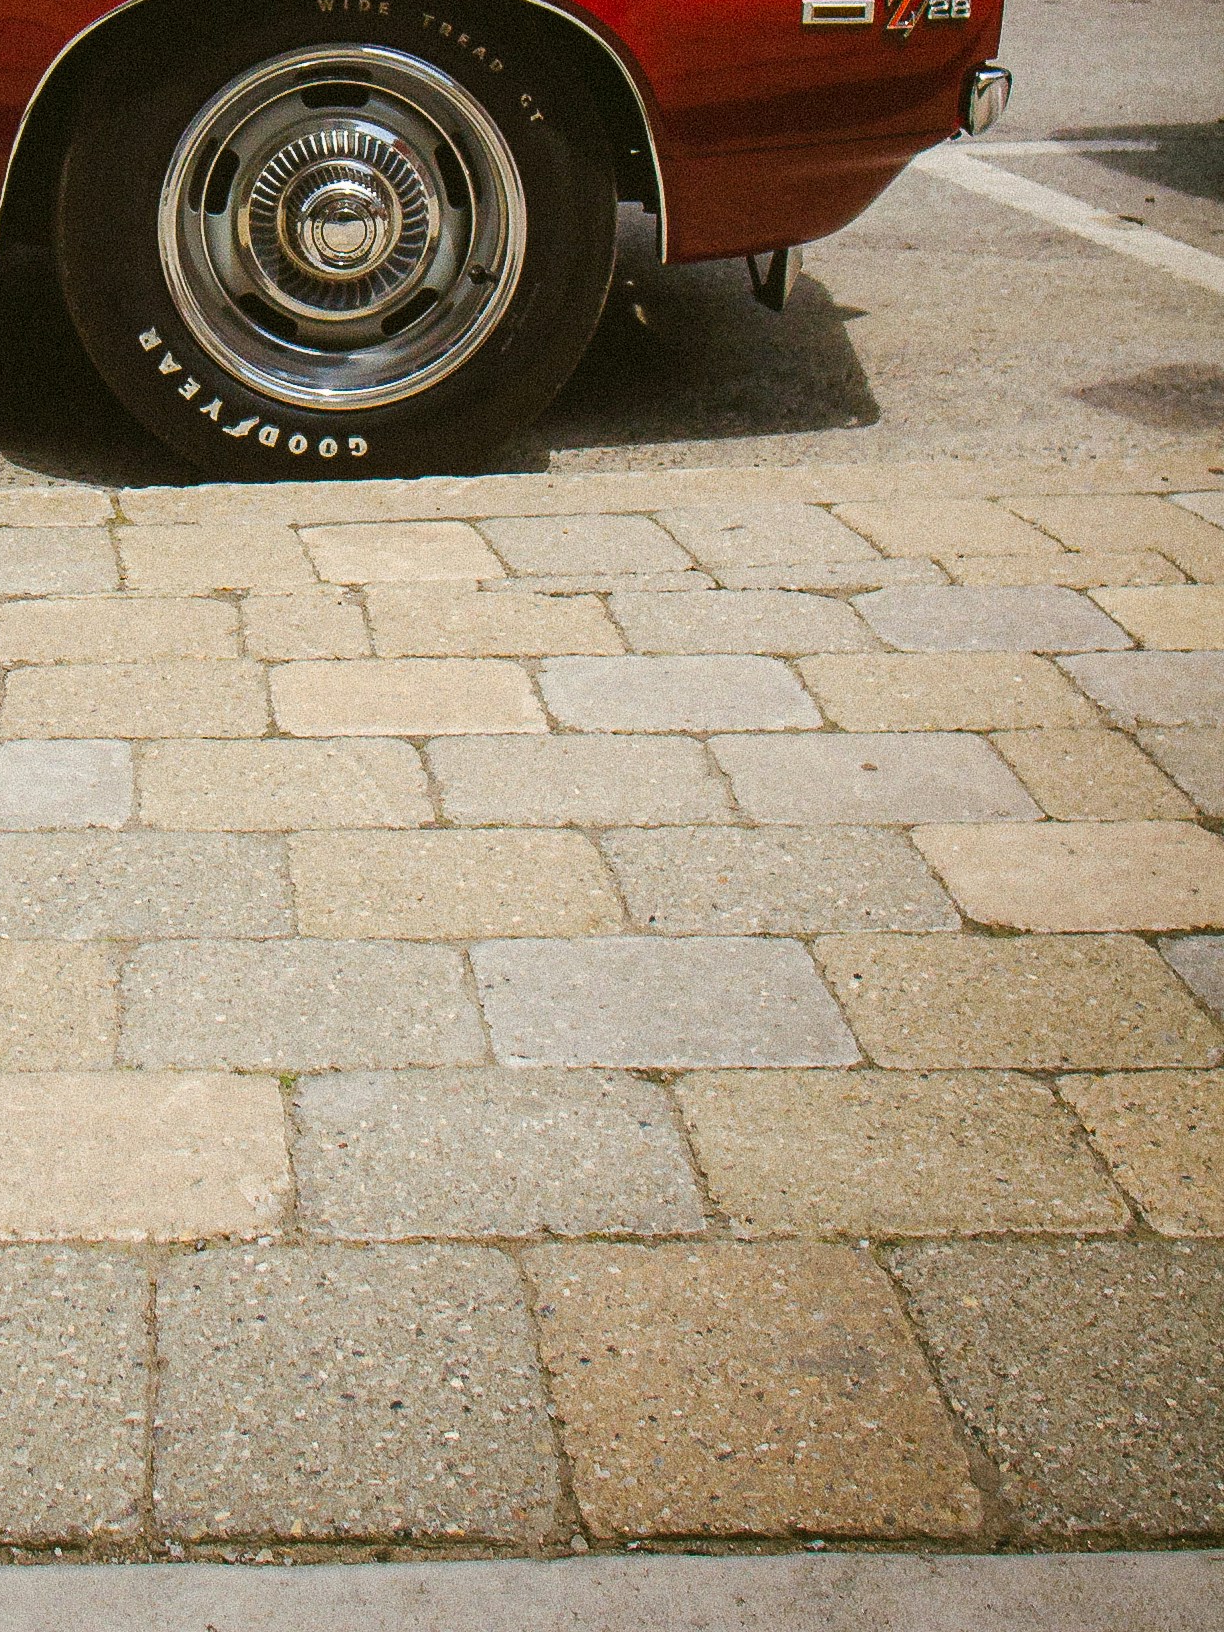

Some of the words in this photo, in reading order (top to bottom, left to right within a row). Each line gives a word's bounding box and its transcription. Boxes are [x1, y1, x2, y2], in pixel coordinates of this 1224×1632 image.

[422, 13, 504, 72] TREAD
[520, 93, 544, 122] GT
[138, 326, 368, 457] GOODYEAR
